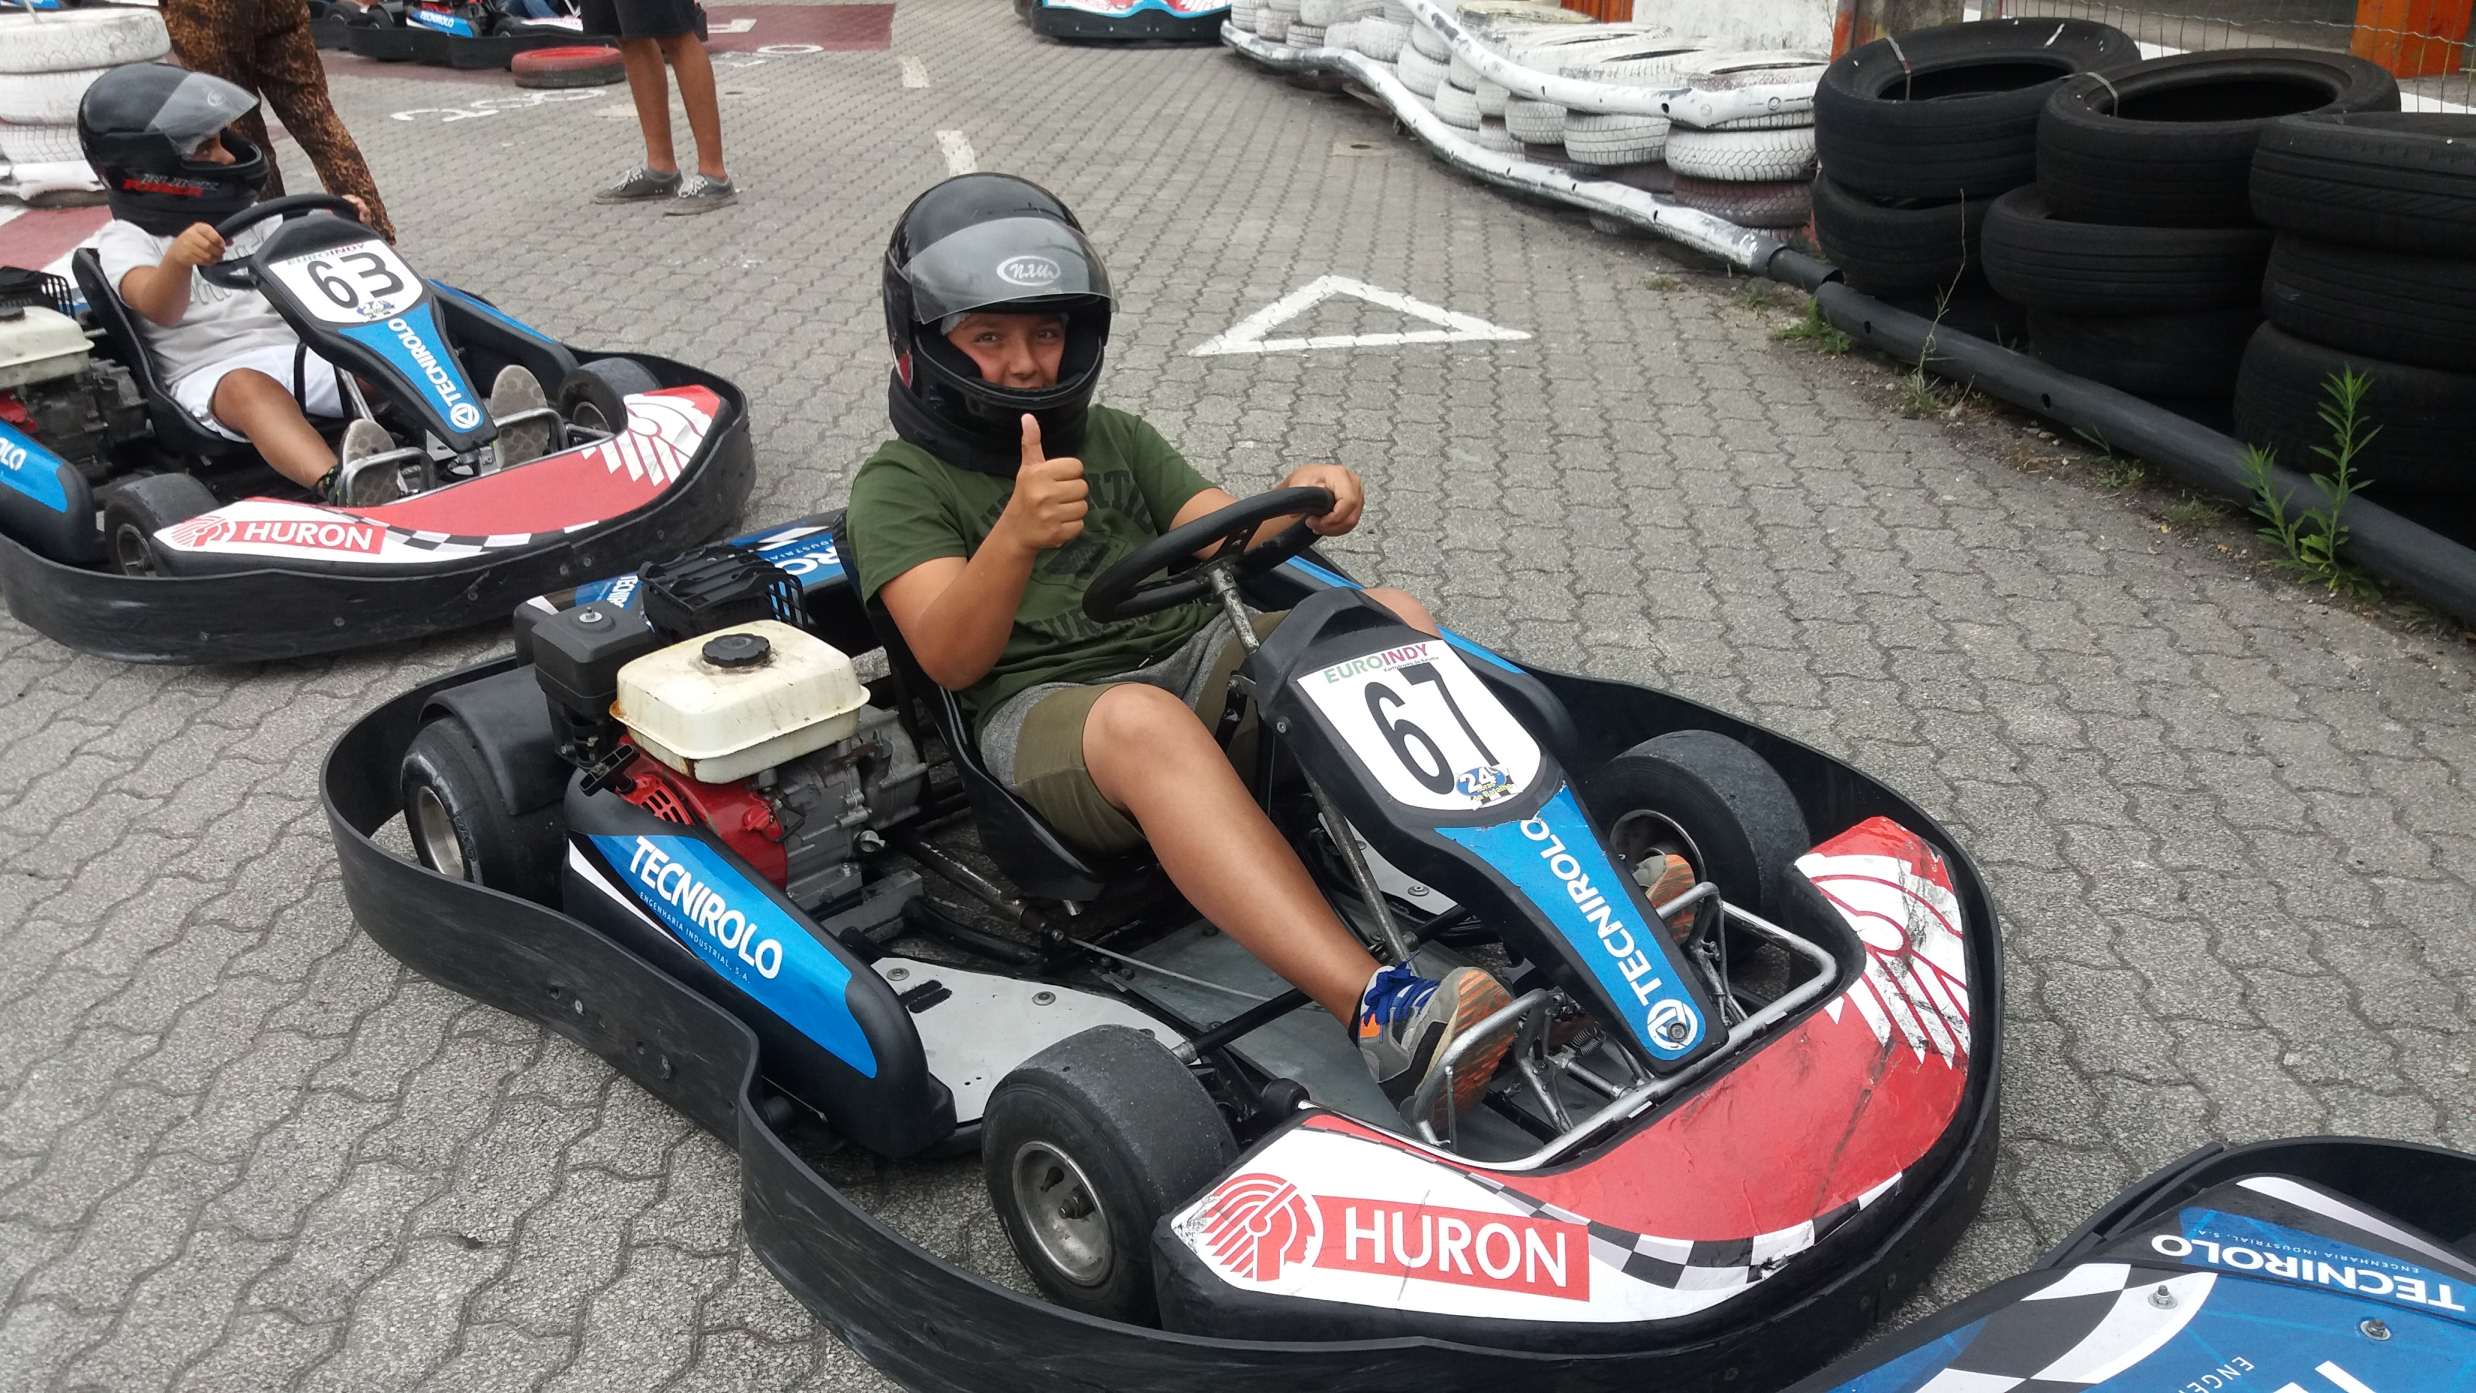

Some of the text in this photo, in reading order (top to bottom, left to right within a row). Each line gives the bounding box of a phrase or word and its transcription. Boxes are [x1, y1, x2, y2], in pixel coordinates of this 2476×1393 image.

[306, 252, 404, 308] 63
[388, 318, 463, 407] TECNIROLO
[243, 522, 374, 550] HURON
[1323, 643, 1429, 684] EUROINDY
[1364, 662, 1500, 795] 67
[630, 835, 783, 980] TECNIROLO
[639, 891, 683, 931] ENGENHARIA
[1520, 818, 1663, 1007] TECNIROLO
[1344, 1206, 1567, 1288] HURON
[2151, 1234, 2466, 1312] TECNIROLO
[2323, 1252, 2419, 1273] ENGENHARIA
